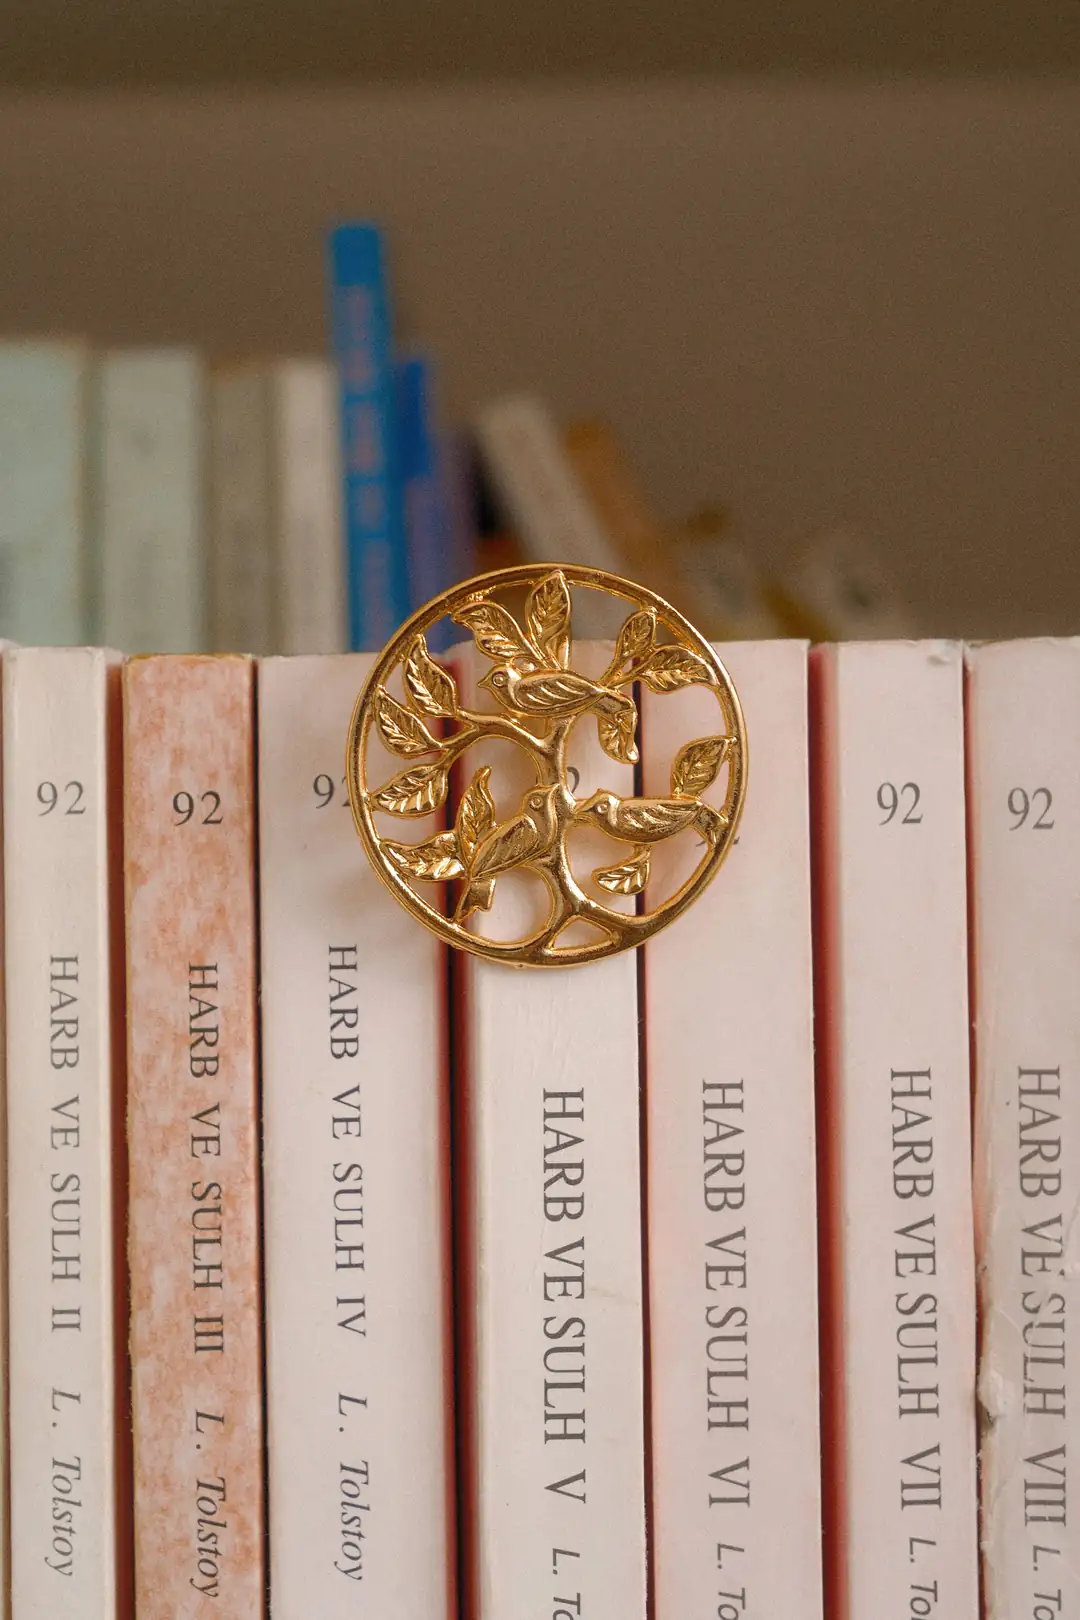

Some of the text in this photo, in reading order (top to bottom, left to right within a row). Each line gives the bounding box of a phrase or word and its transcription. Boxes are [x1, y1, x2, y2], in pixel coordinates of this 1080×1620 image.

[36, 780, 86, 816] 92
[172, 790, 224, 827] 92
[876, 781, 923, 826] 92
[1007, 787, 1055, 831] 92
[542, 1087, 585, 1222] HARB
[702, 1079, 746, 1213] HARB
[890, 1067, 935, 1200] HARB
[1017, 1065, 1062, 1198] HARB
[44, 955, 83, 1577] HARB VE SULH II L. Tolstoy
[328, 944, 371, 1581] HARB VE SULH IV L. Tolstoy
[543, 1235, 585, 1302] VE
[704, 1226, 747, 1292] VE
[894, 1213, 937, 1278] VE
[1020, 1213, 1066, 1278] VE
[188, 961, 228, 1598] HARB VE SULH III L. Tolstoy
[542, 1316, 586, 1445] SULH
[705, 1305, 749, 1432] SULH
[895, 1292, 940, 1419] SULH
[1021, 1290, 1066, 1419] SULH
[544, 1468, 587, 1504] V
[707, 1456, 751, 1508] VI
[899, 1443, 942, 1511] VII
[1023, 1443, 1067, 1527] VIII
[552, 1547, 581, 1575] L.
[716, 1542, 745, 1570] L.
[909, 1537, 937, 1564] L.
[1032, 1544, 1061, 1572] L.
